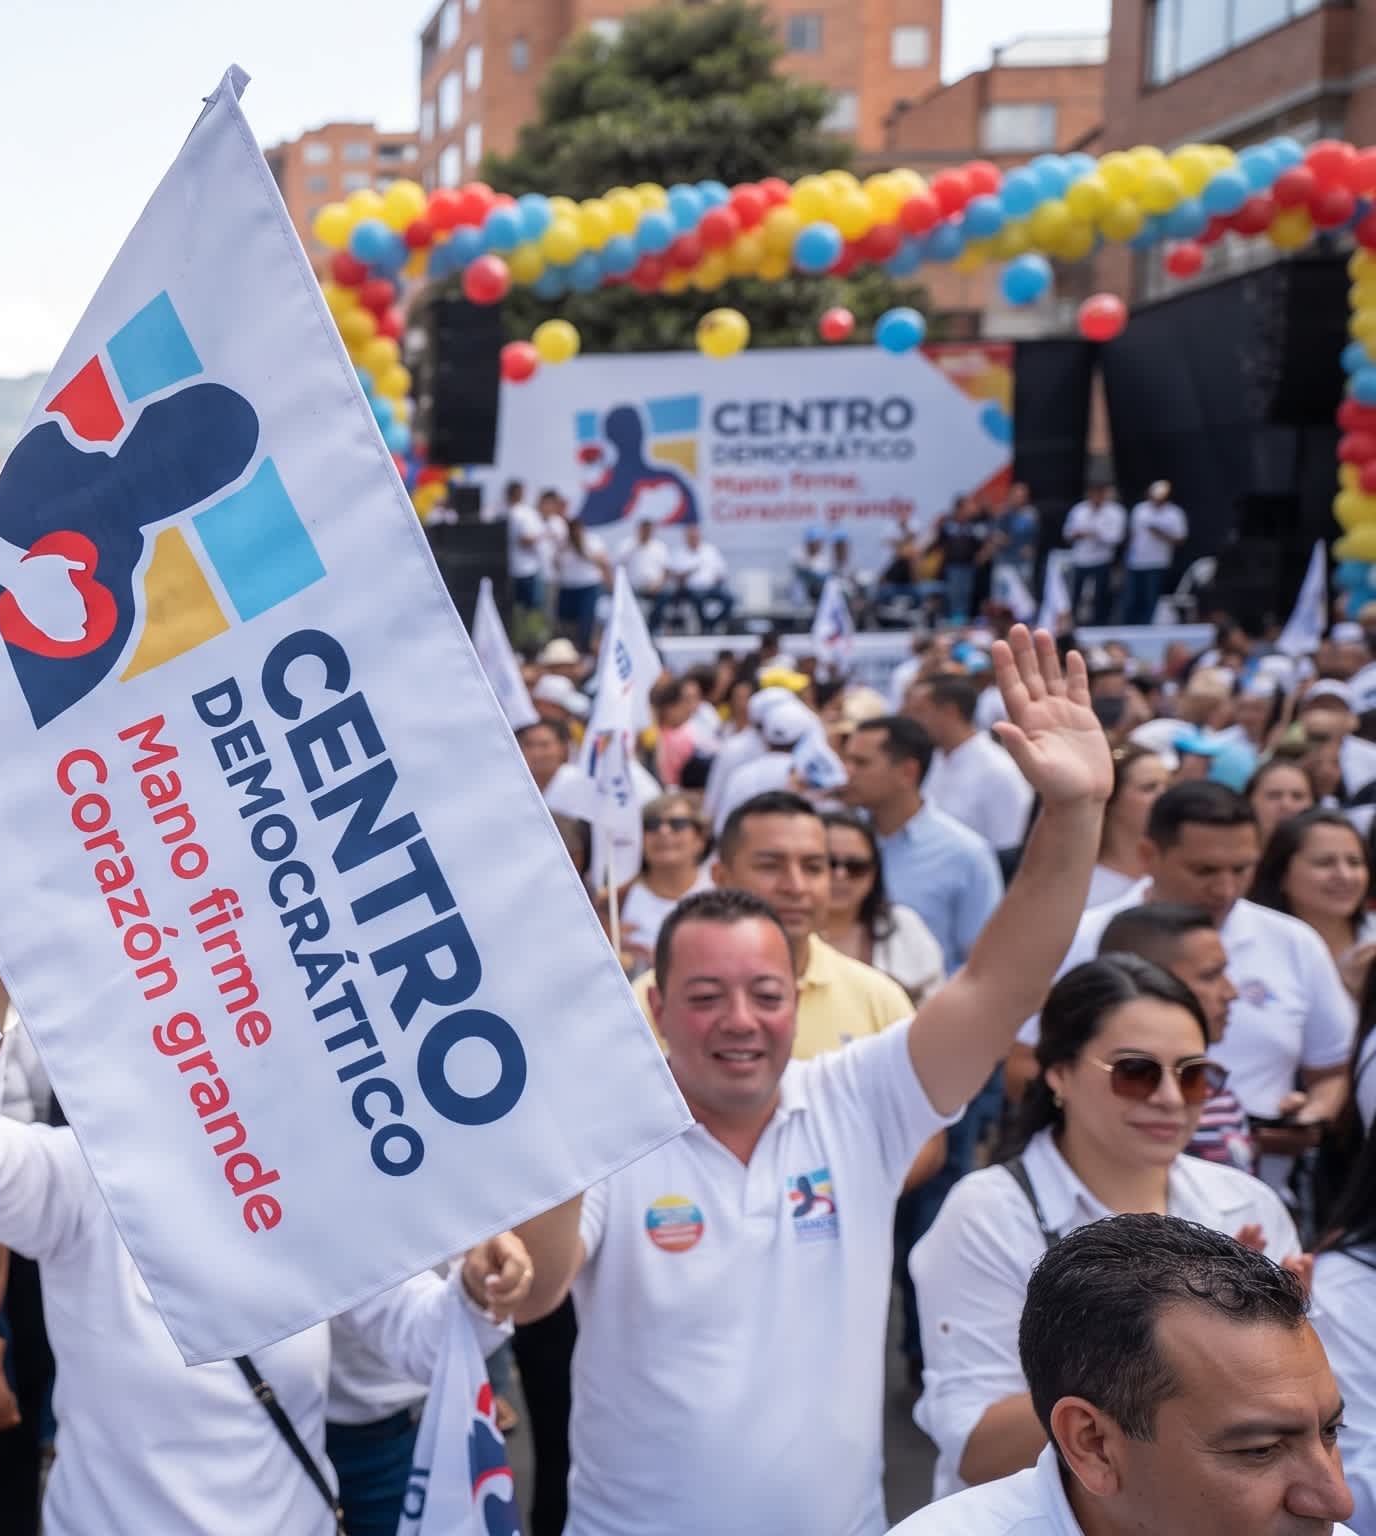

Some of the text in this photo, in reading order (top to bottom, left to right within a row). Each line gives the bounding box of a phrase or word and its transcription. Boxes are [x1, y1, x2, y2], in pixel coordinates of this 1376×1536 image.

[712, 396, 916, 438] CENTRO
[56, 748, 283, 1233] Corazón grande
[118, 714, 272, 1047] Mano firme
[261, 629, 527, 1126] CENTRO
